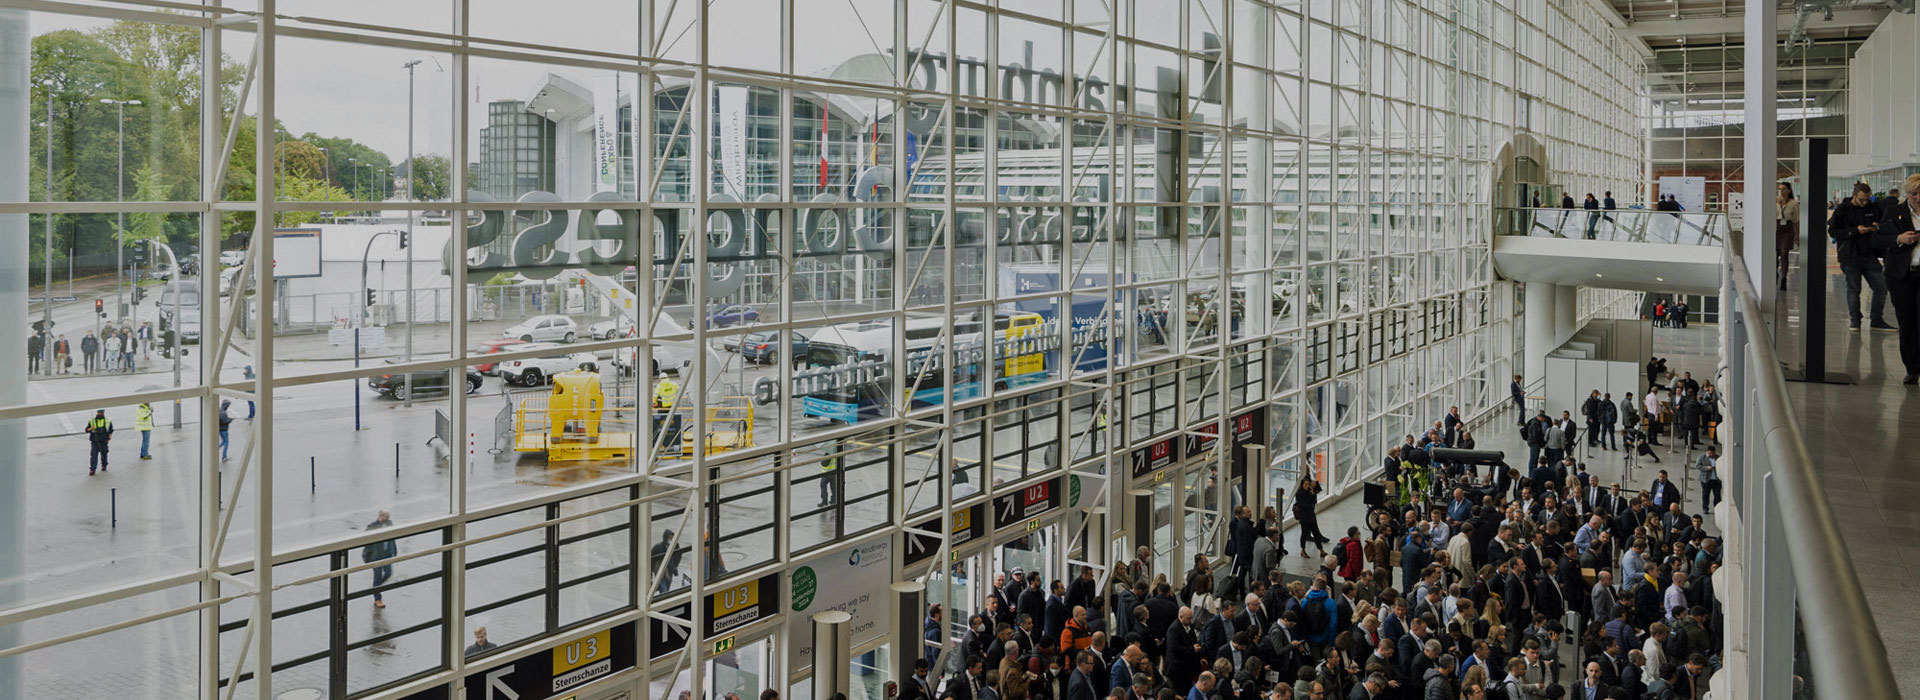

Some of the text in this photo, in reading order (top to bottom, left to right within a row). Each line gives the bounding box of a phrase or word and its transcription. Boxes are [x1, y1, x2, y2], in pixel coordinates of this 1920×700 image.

[859, 593, 870, 604] say
[715, 610, 758, 631] Sternschanze
[555, 663, 609, 689] Sternschanze
